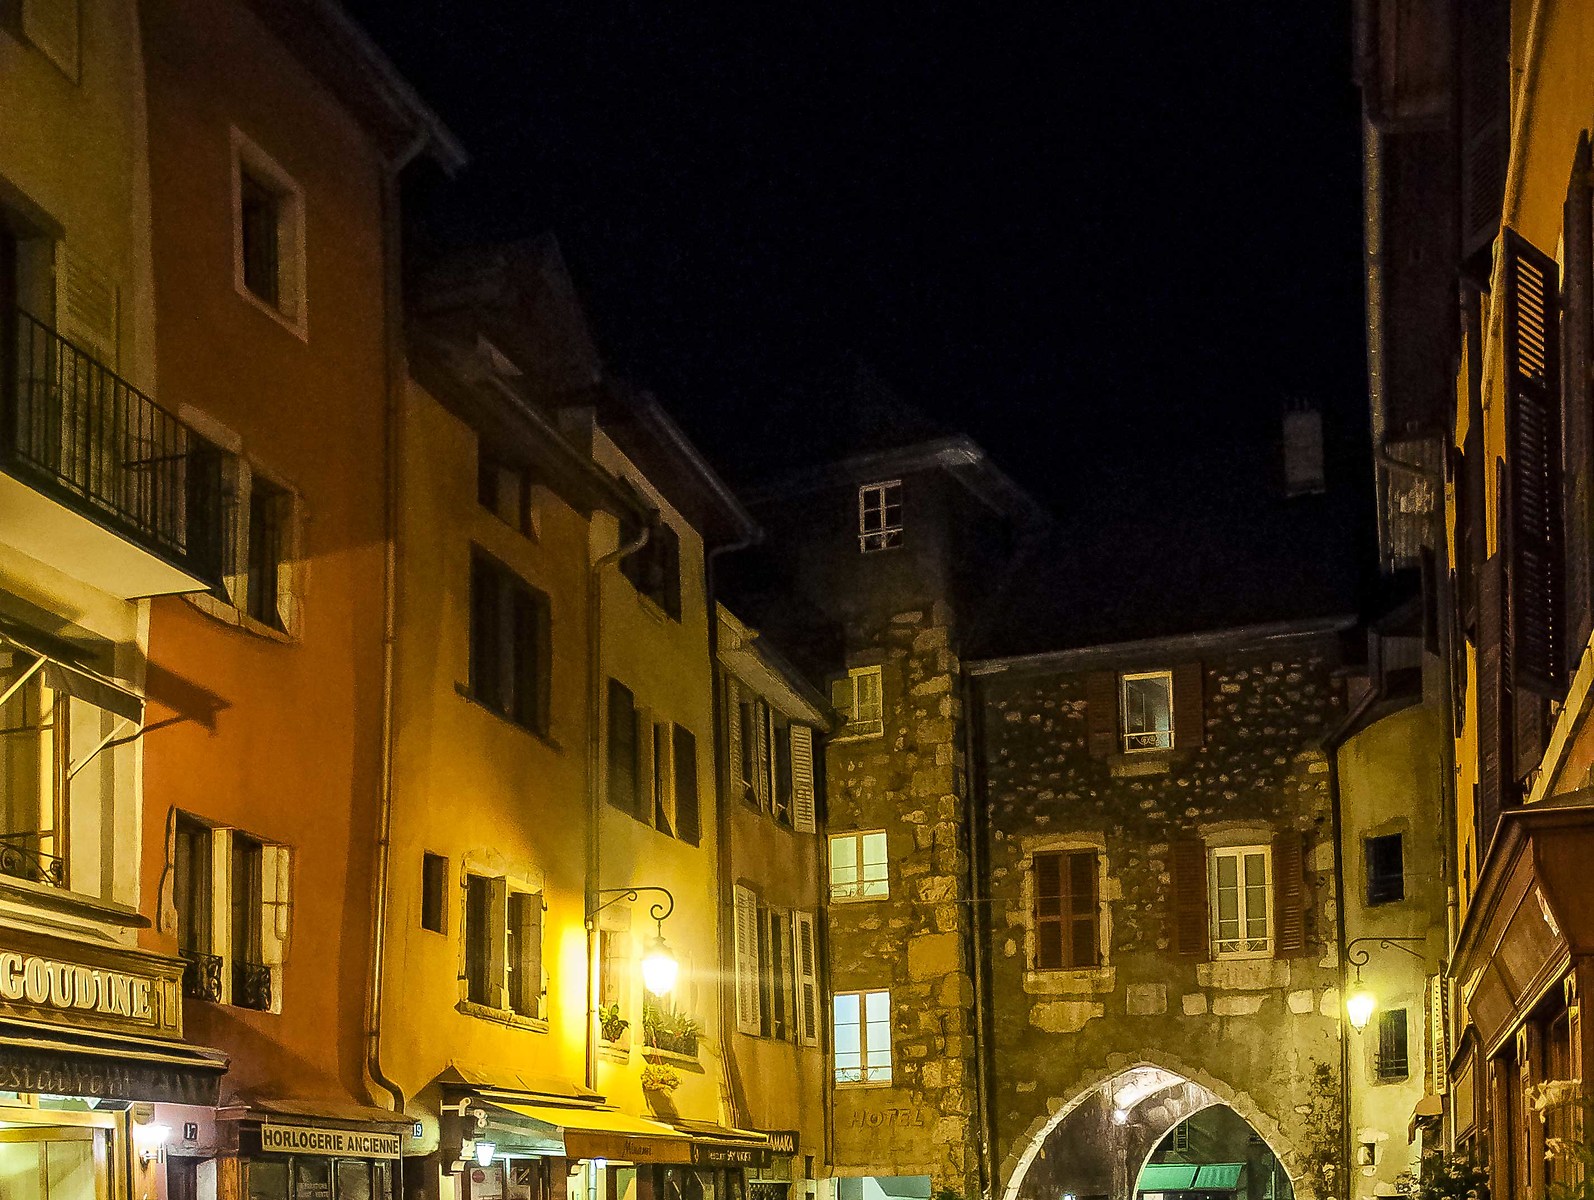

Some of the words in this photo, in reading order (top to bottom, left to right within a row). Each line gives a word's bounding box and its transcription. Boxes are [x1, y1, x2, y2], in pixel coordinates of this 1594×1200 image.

[186, 1124, 196, 1139] 17
[413, 1124, 422, 1137] 19
[263, 1129, 344, 1151] HORLOGERIE
[347, 1136, 399, 1154] ANCIENNE
